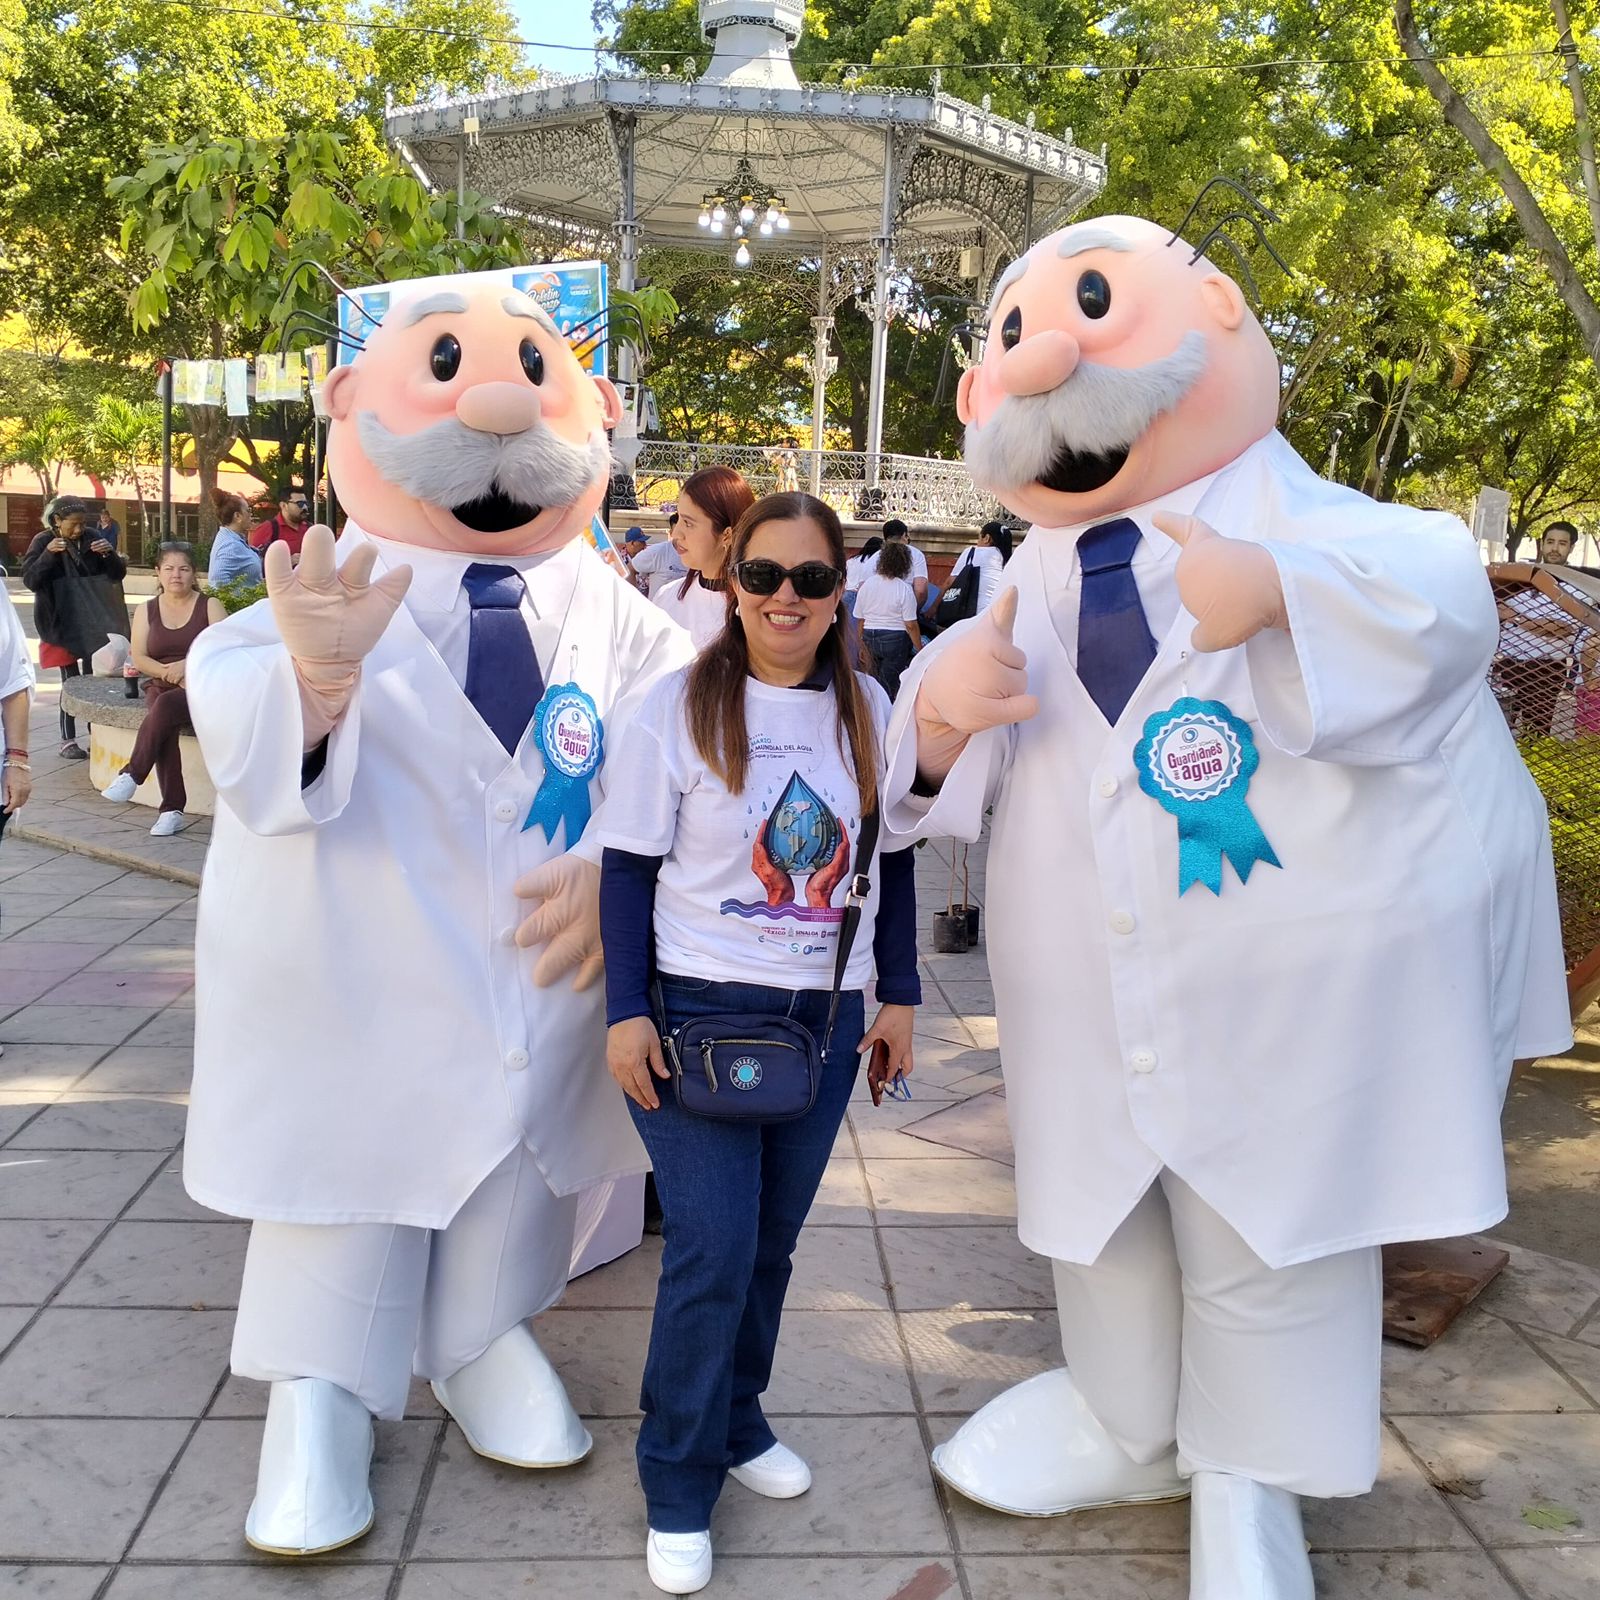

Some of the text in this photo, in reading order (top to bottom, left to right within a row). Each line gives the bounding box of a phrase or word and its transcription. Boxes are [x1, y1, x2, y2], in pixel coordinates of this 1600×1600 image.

[563, 738, 587, 757] agua
[797, 744, 813, 753] AGUA
[1167, 742, 1223, 769] Guardianes
[1181, 758, 1223, 782] agua
